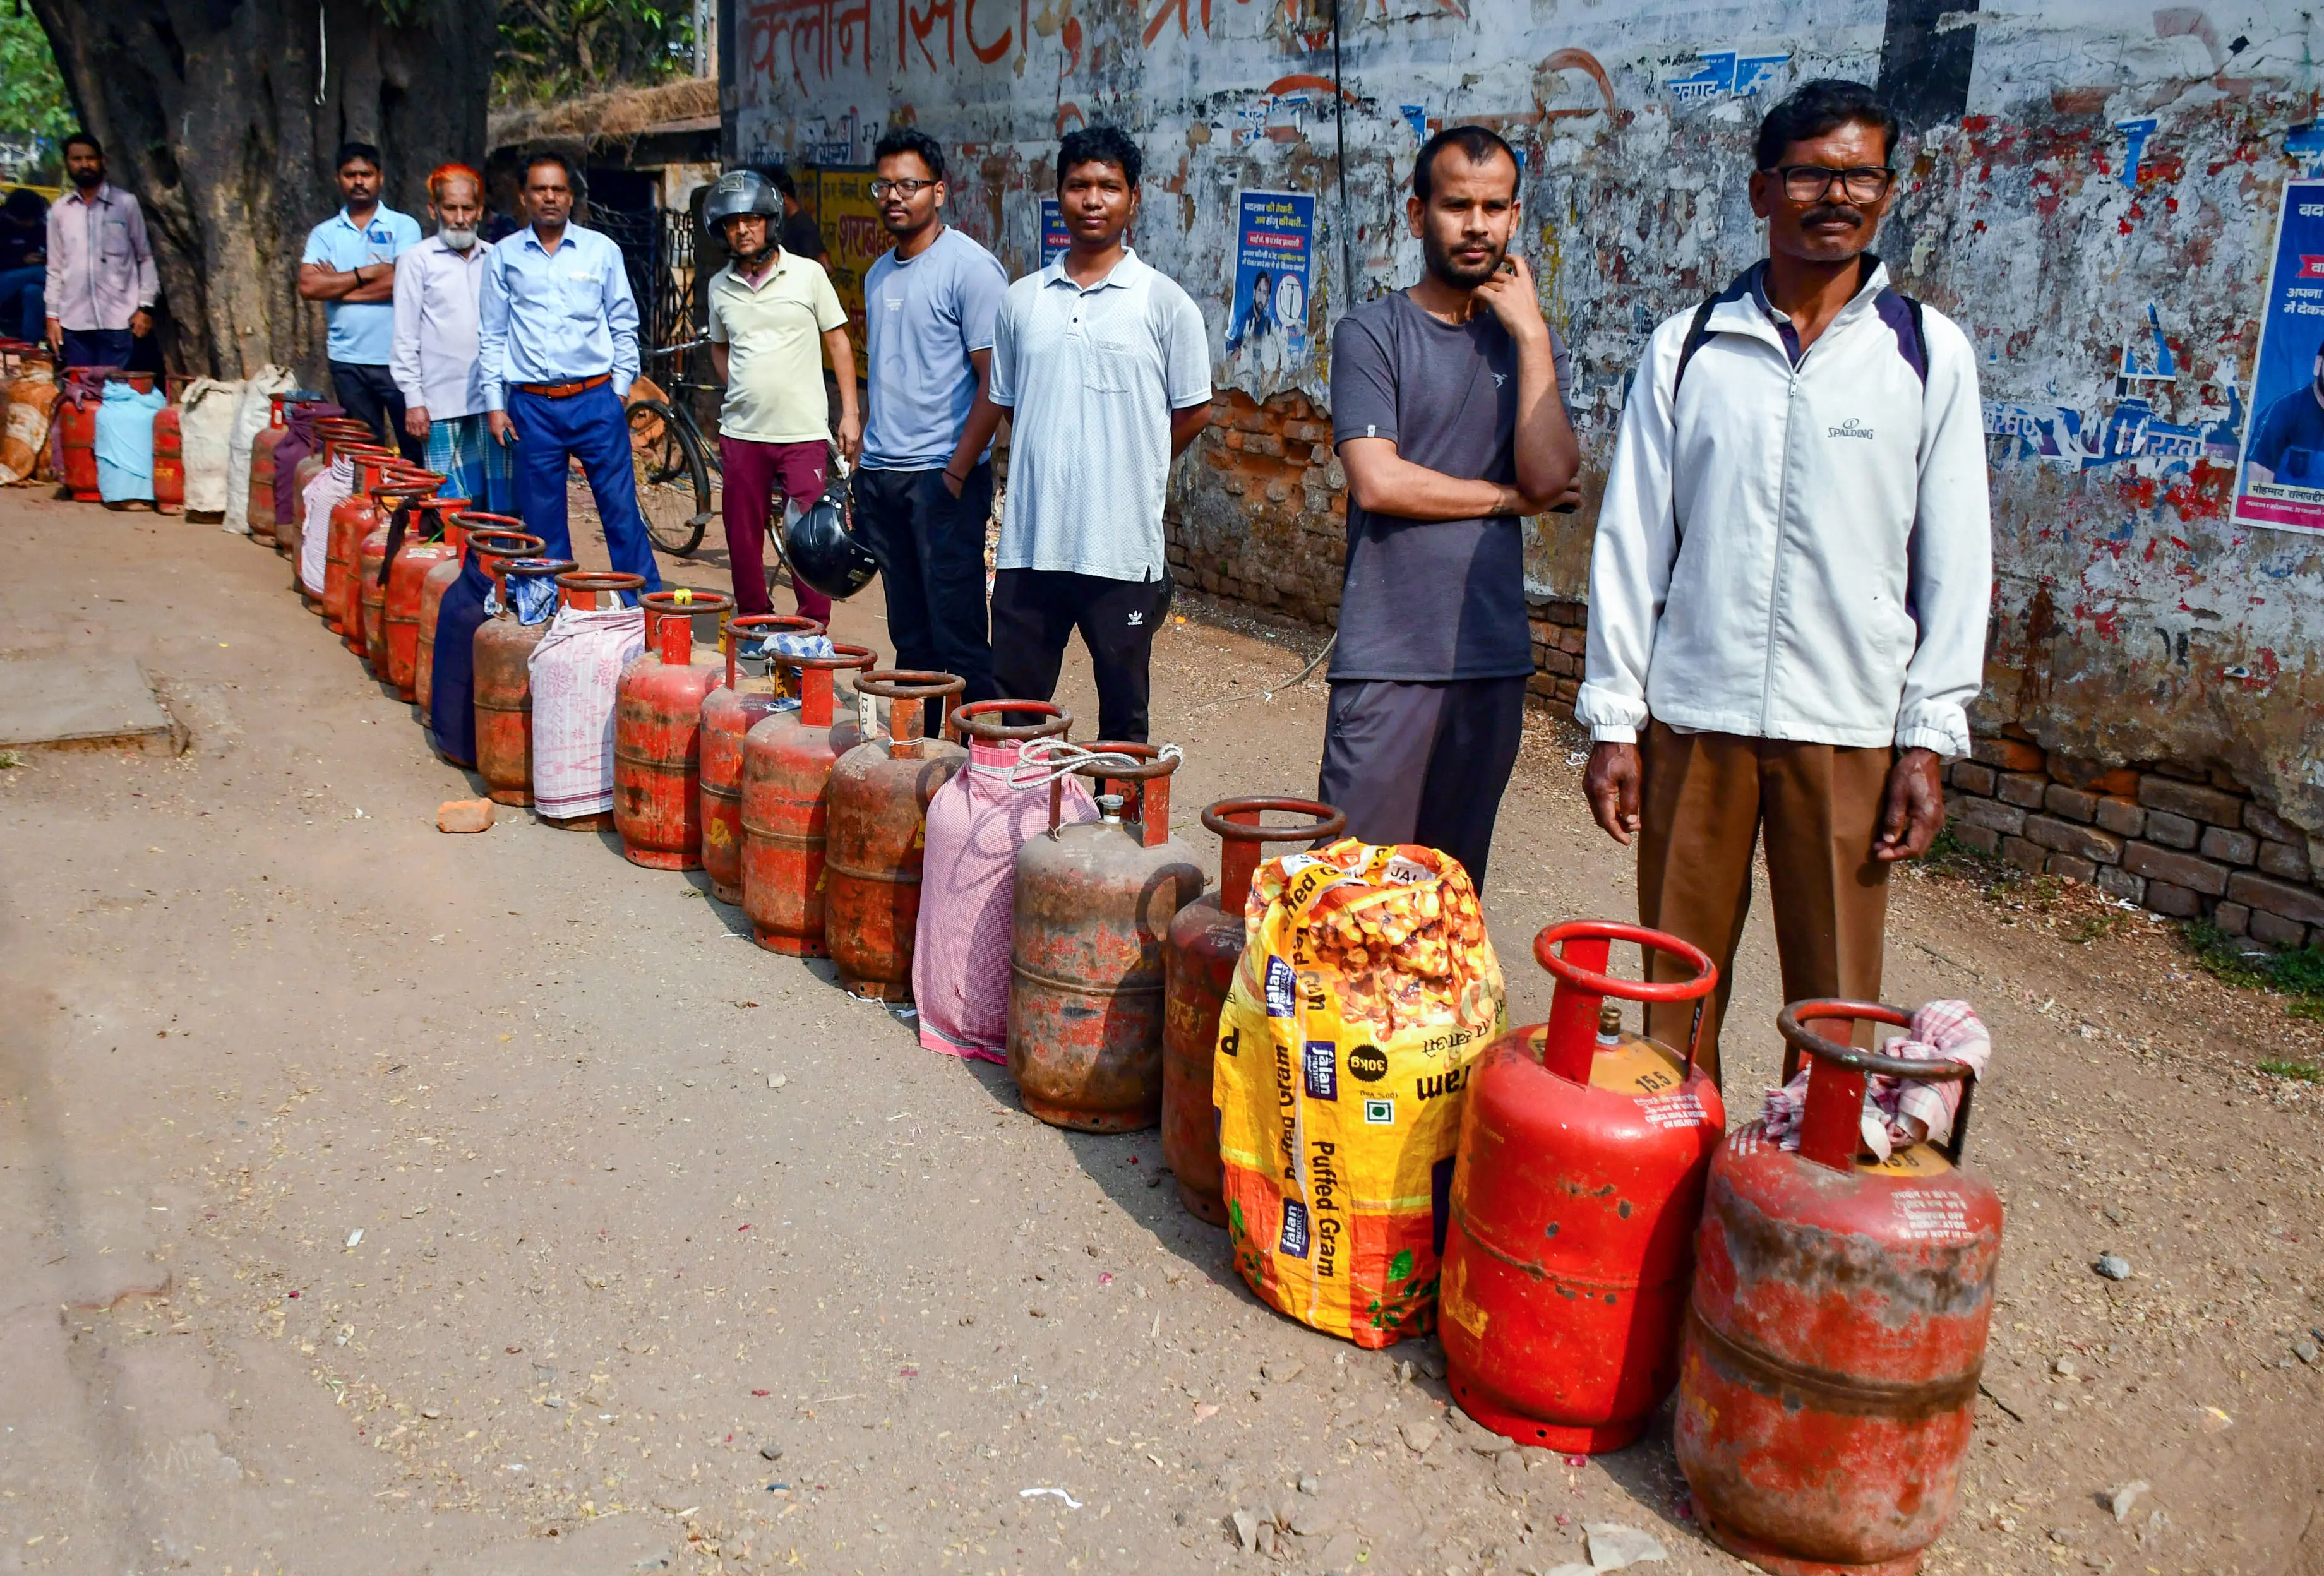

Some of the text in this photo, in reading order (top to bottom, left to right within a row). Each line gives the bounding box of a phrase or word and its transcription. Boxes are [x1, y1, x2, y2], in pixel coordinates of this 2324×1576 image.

[2286, 287, 2323, 299] अपना
[2284, 301, 2296, 314] में
[1827, 427, 1874, 440] SPALDING
[1266, 962, 1285, 1012] jalan
[1313, 1047, 1333, 1095] jalan
[1350, 1054, 1386, 1072] 30kg
[1634, 1070, 1672, 1094] 15.5
[1360, 1089, 1375, 1097] Veg
[1311, 1140, 1341, 1278] Puffed Gram
[1282, 1205, 1300, 1251] jalan
